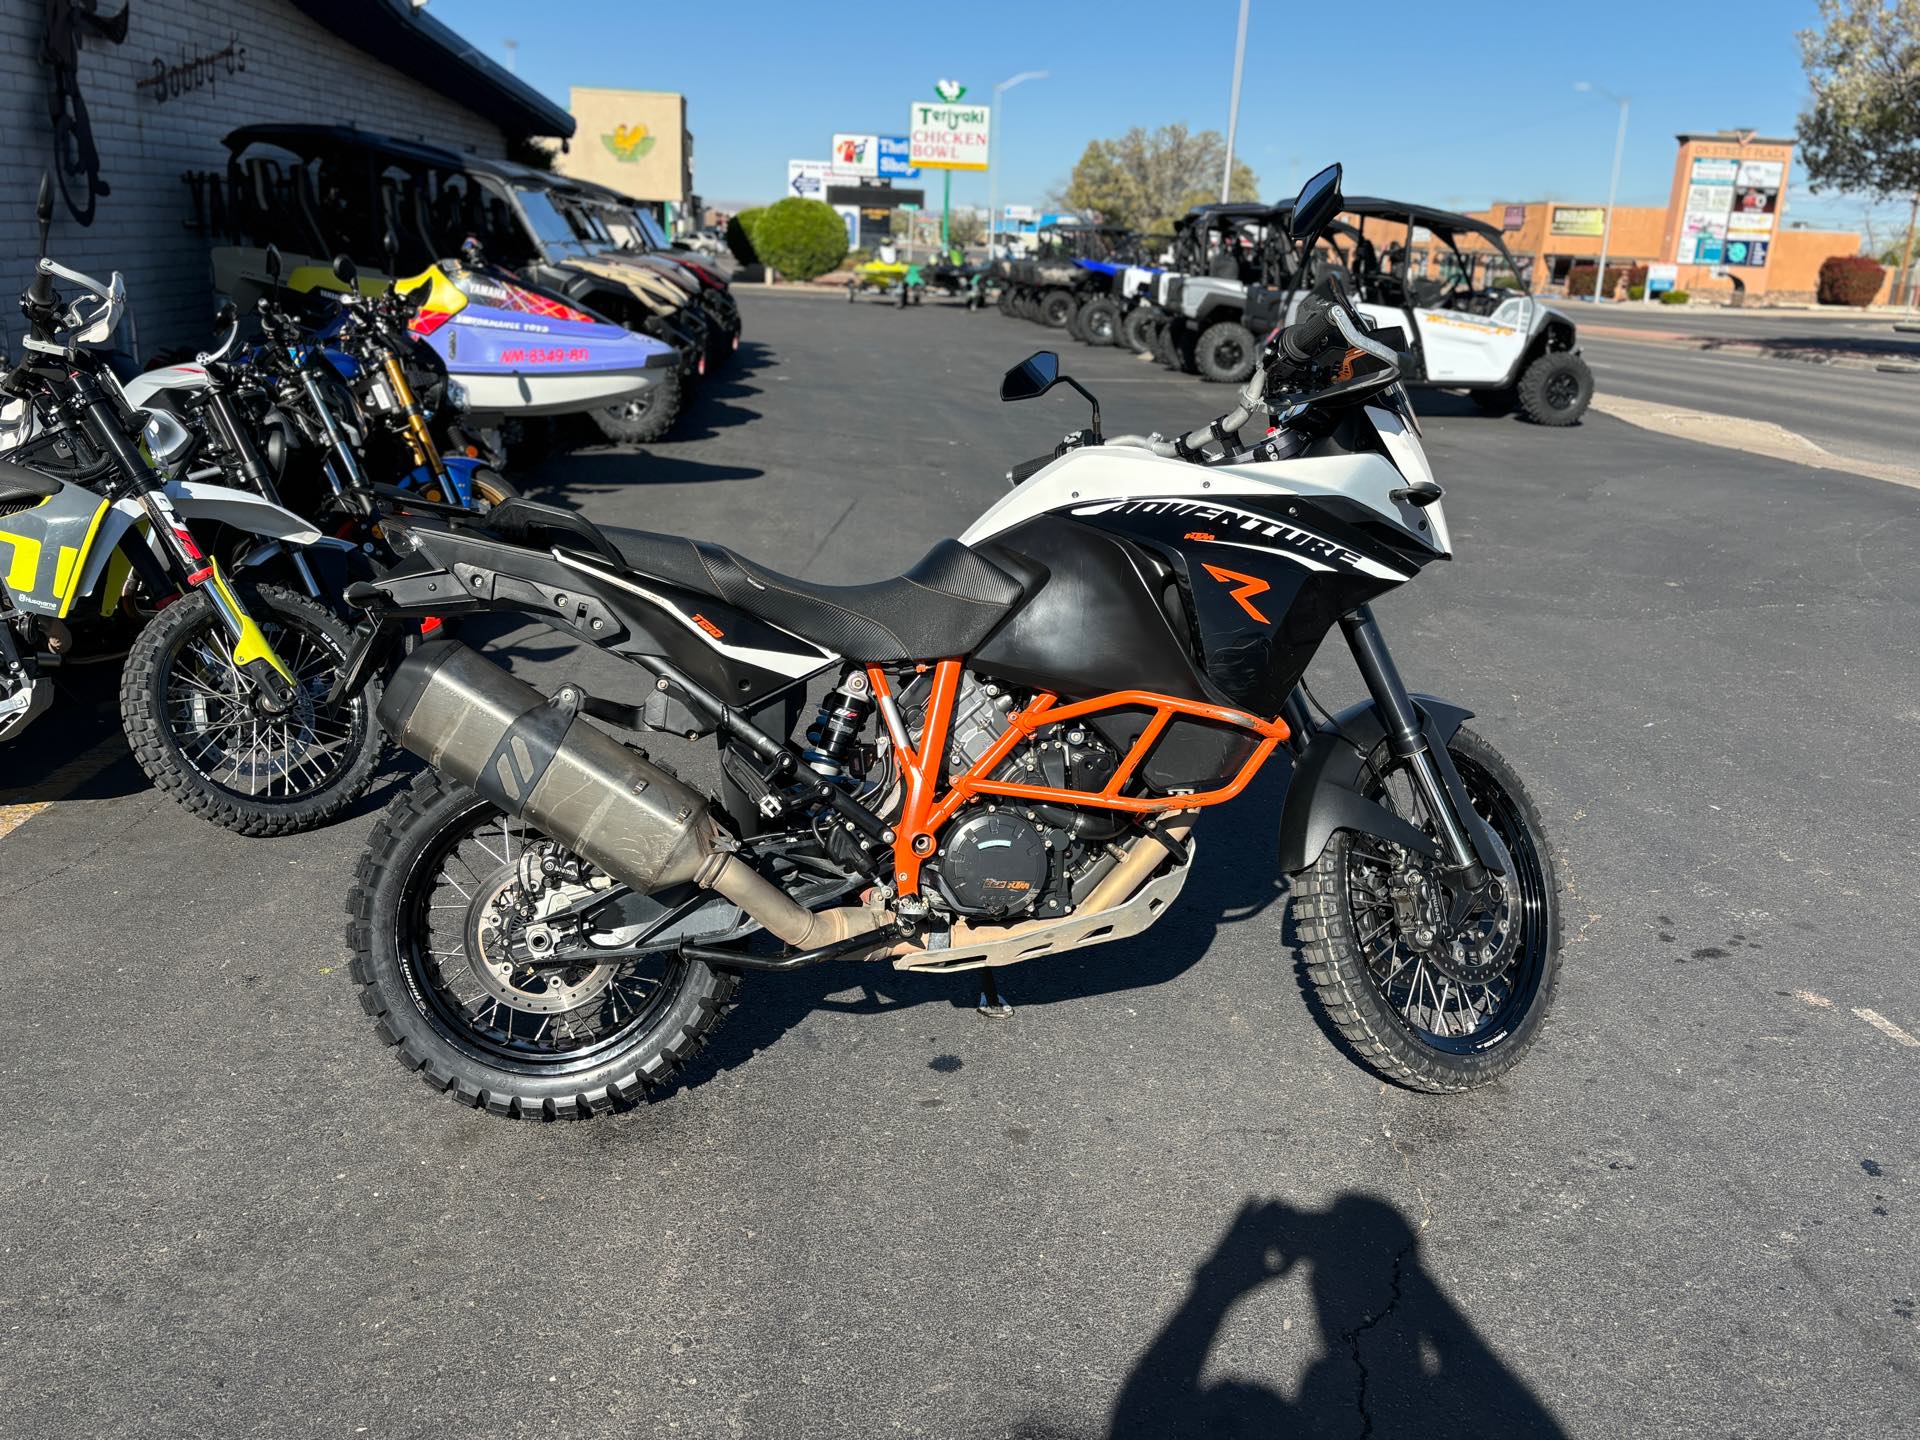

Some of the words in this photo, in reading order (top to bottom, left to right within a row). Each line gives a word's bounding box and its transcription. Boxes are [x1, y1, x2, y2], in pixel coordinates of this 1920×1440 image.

[152, 42, 216, 104] Bobby
[919, 107, 985, 131] Teriyaki
[911, 129, 987, 145] CHICKEN
[911, 145, 960, 159] BOWL
[469, 282, 507, 300] YAMAHA
[1112, 500, 1365, 567] ADVENTURE
[1184, 532, 1215, 541] KTM
[1201, 562, 1271, 625] R
[1430, 888, 1442, 921] brembo
